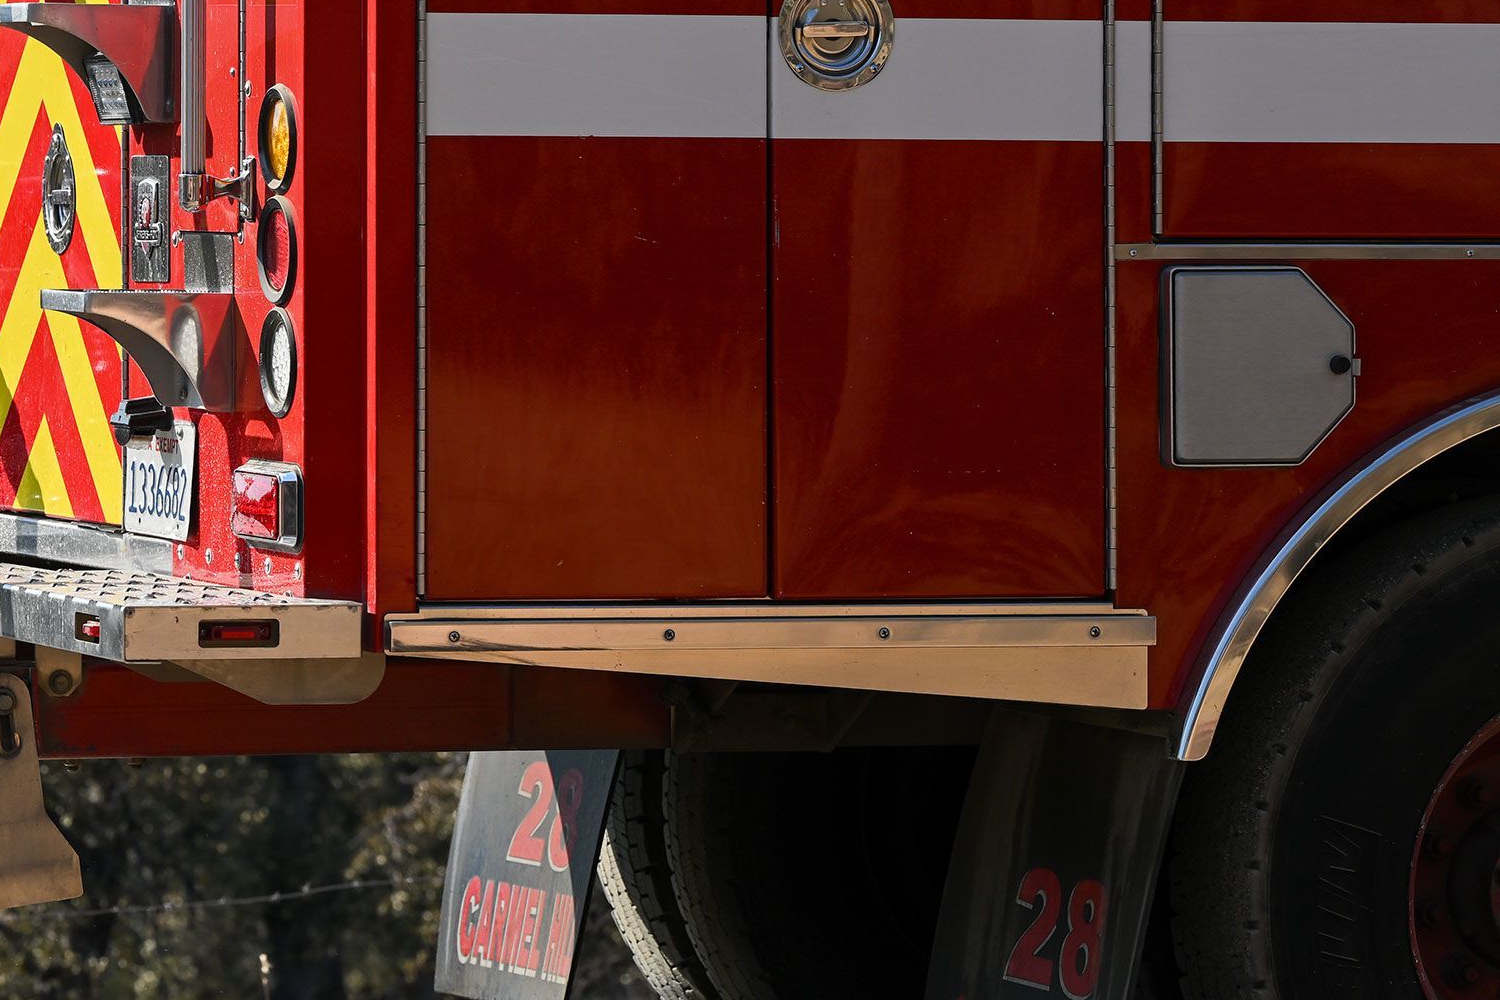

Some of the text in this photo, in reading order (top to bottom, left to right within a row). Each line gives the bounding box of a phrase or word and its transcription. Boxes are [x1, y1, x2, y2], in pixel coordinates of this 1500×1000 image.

[128, 460, 188, 521] 1336682
[505, 760, 584, 872] 28
[456, 874, 547, 978] CARMEL
[1002, 866, 1109, 1000] 28
